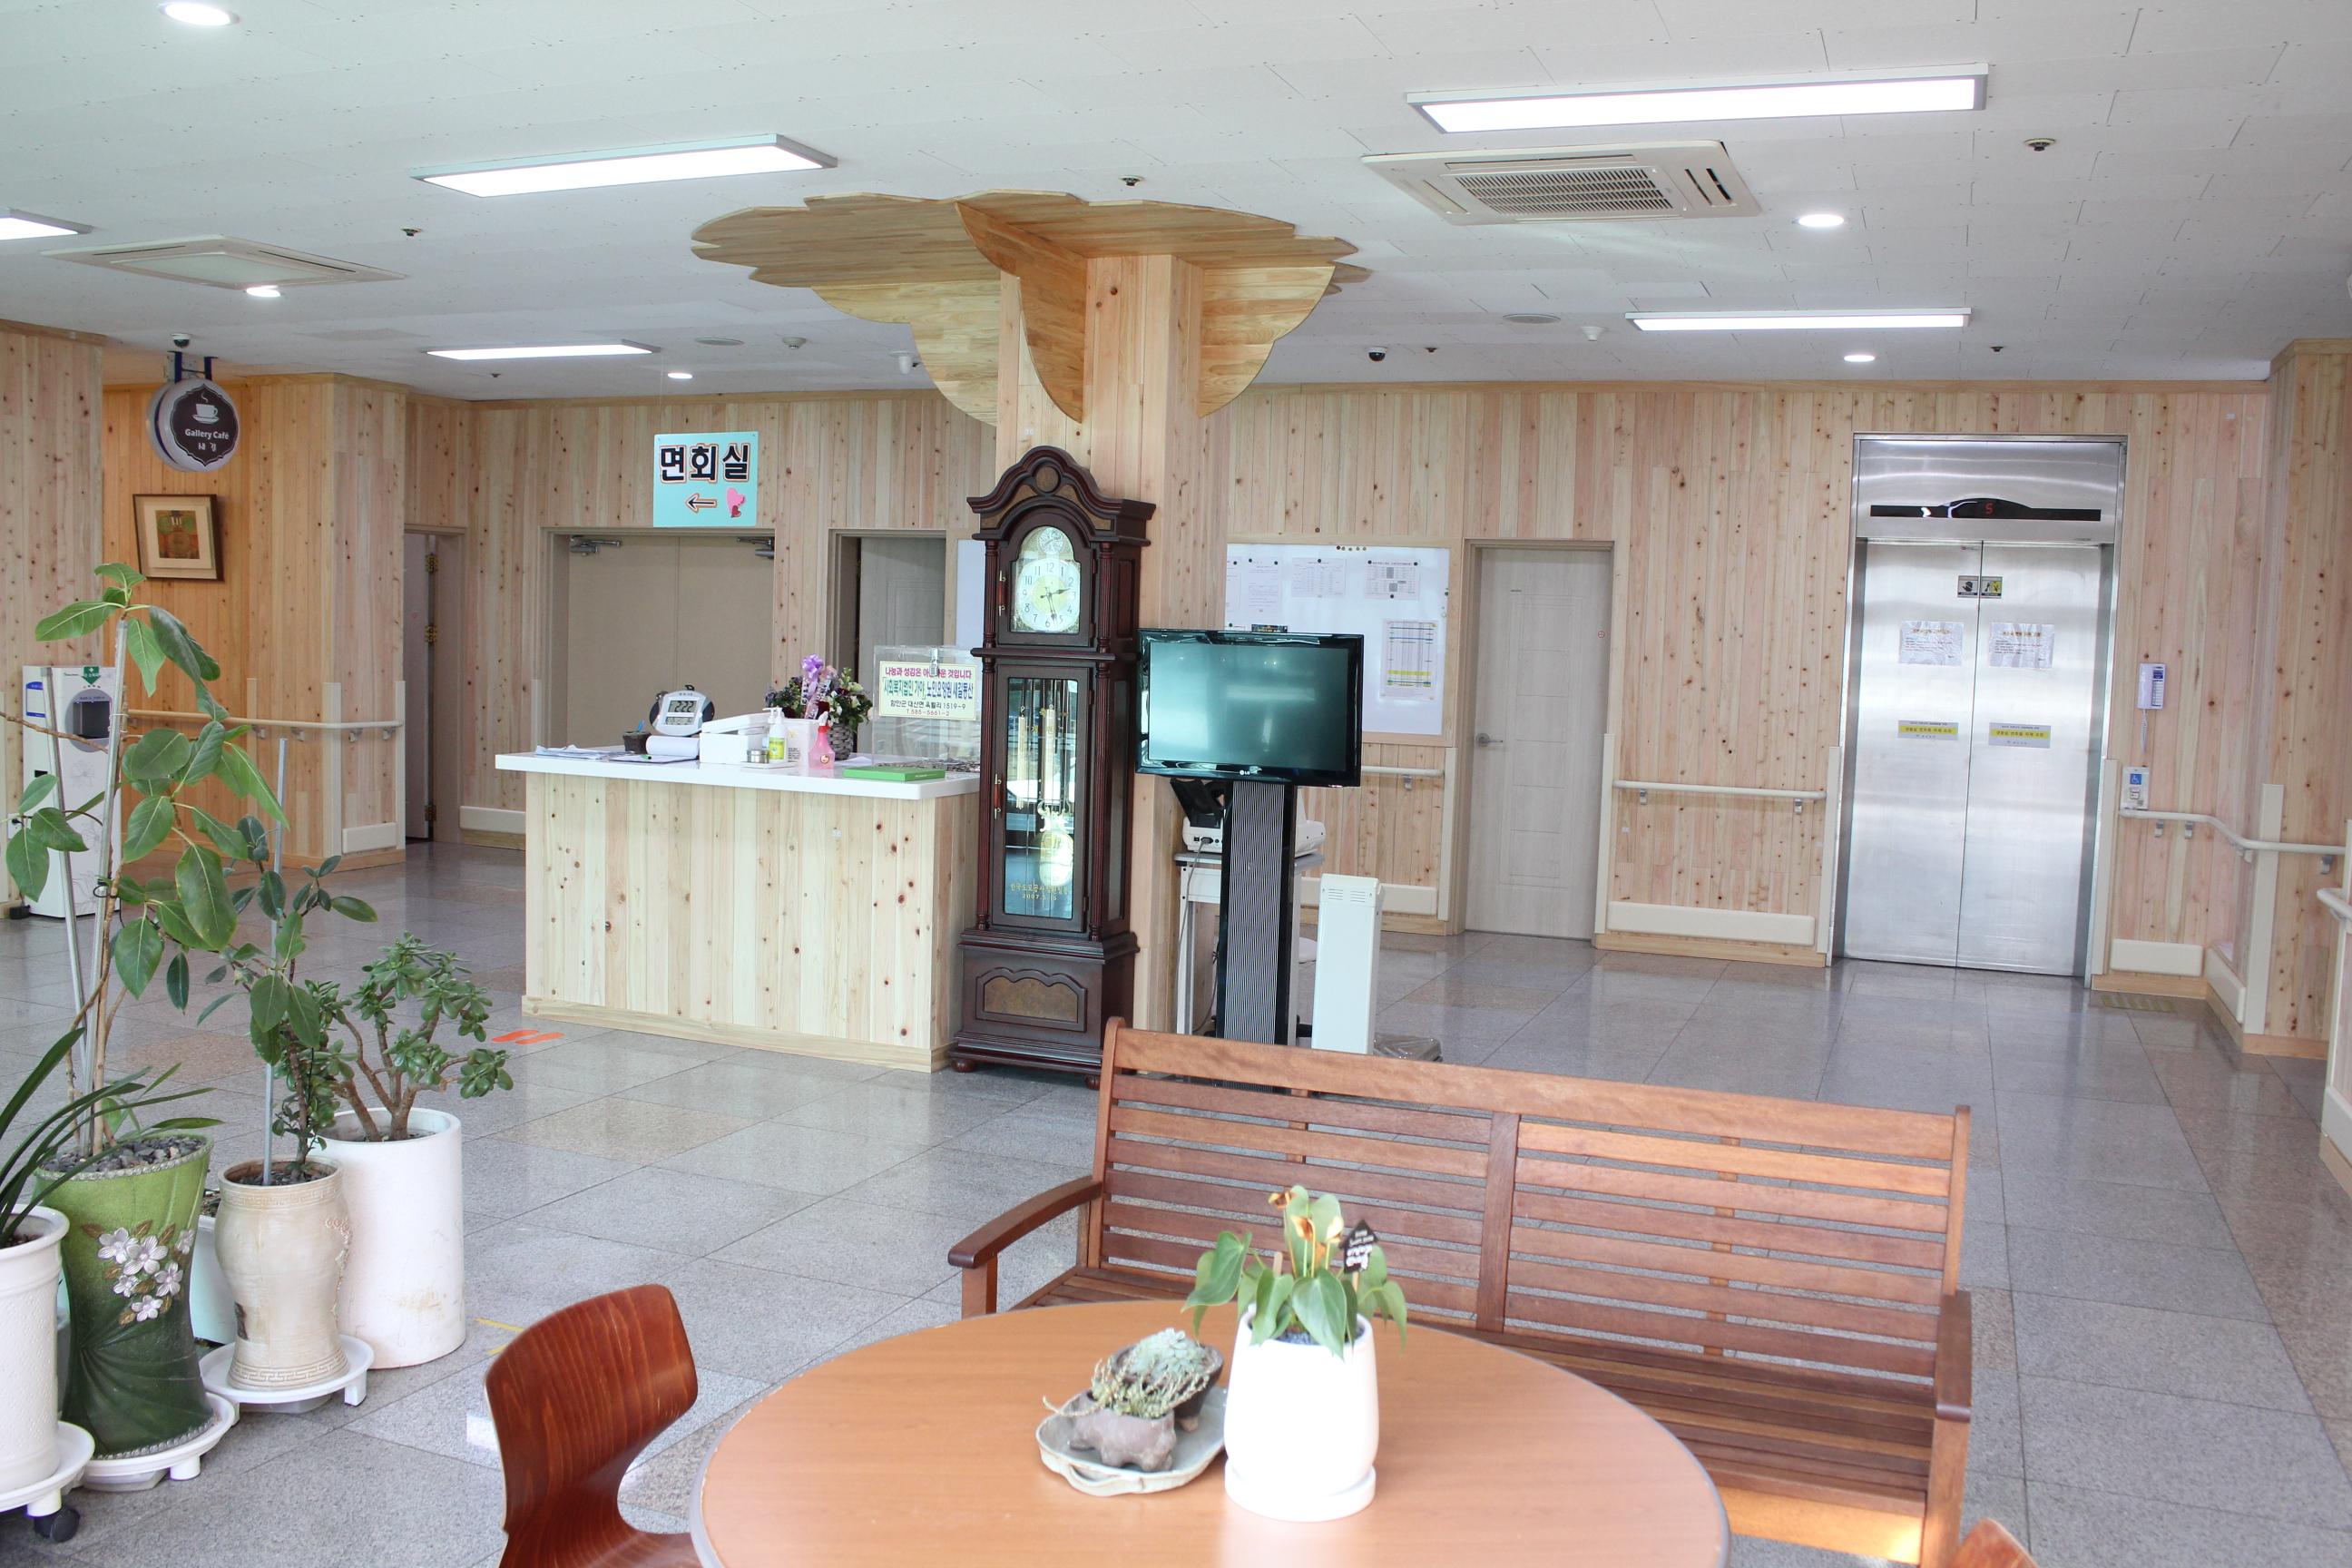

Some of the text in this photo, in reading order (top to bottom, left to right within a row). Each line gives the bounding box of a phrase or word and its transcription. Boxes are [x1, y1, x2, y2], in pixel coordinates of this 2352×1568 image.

[184, 428, 212, 440] Gallery
[660, 444, 749, 482] 면회실
[1034, 566, 1041, 576] 11
[1046, 563, 1054, 573] 12
[1025, 575, 1033, 585] 10
[1068, 577, 1074, 587] 2
[1024, 603, 1031, 613] 8
[1067, 605, 1073, 614] 4
[1034, 614, 1038, 623] 7
[1045, 619, 1051, 628] 6
[886, 667, 902, 676] 나눔과
[947, 670, 972, 679] 것입니다
[926, 681, 952, 699] 노인요양원
[953, 681, 974, 700] 새길동산
[890, 700, 906, 708] 함안군
